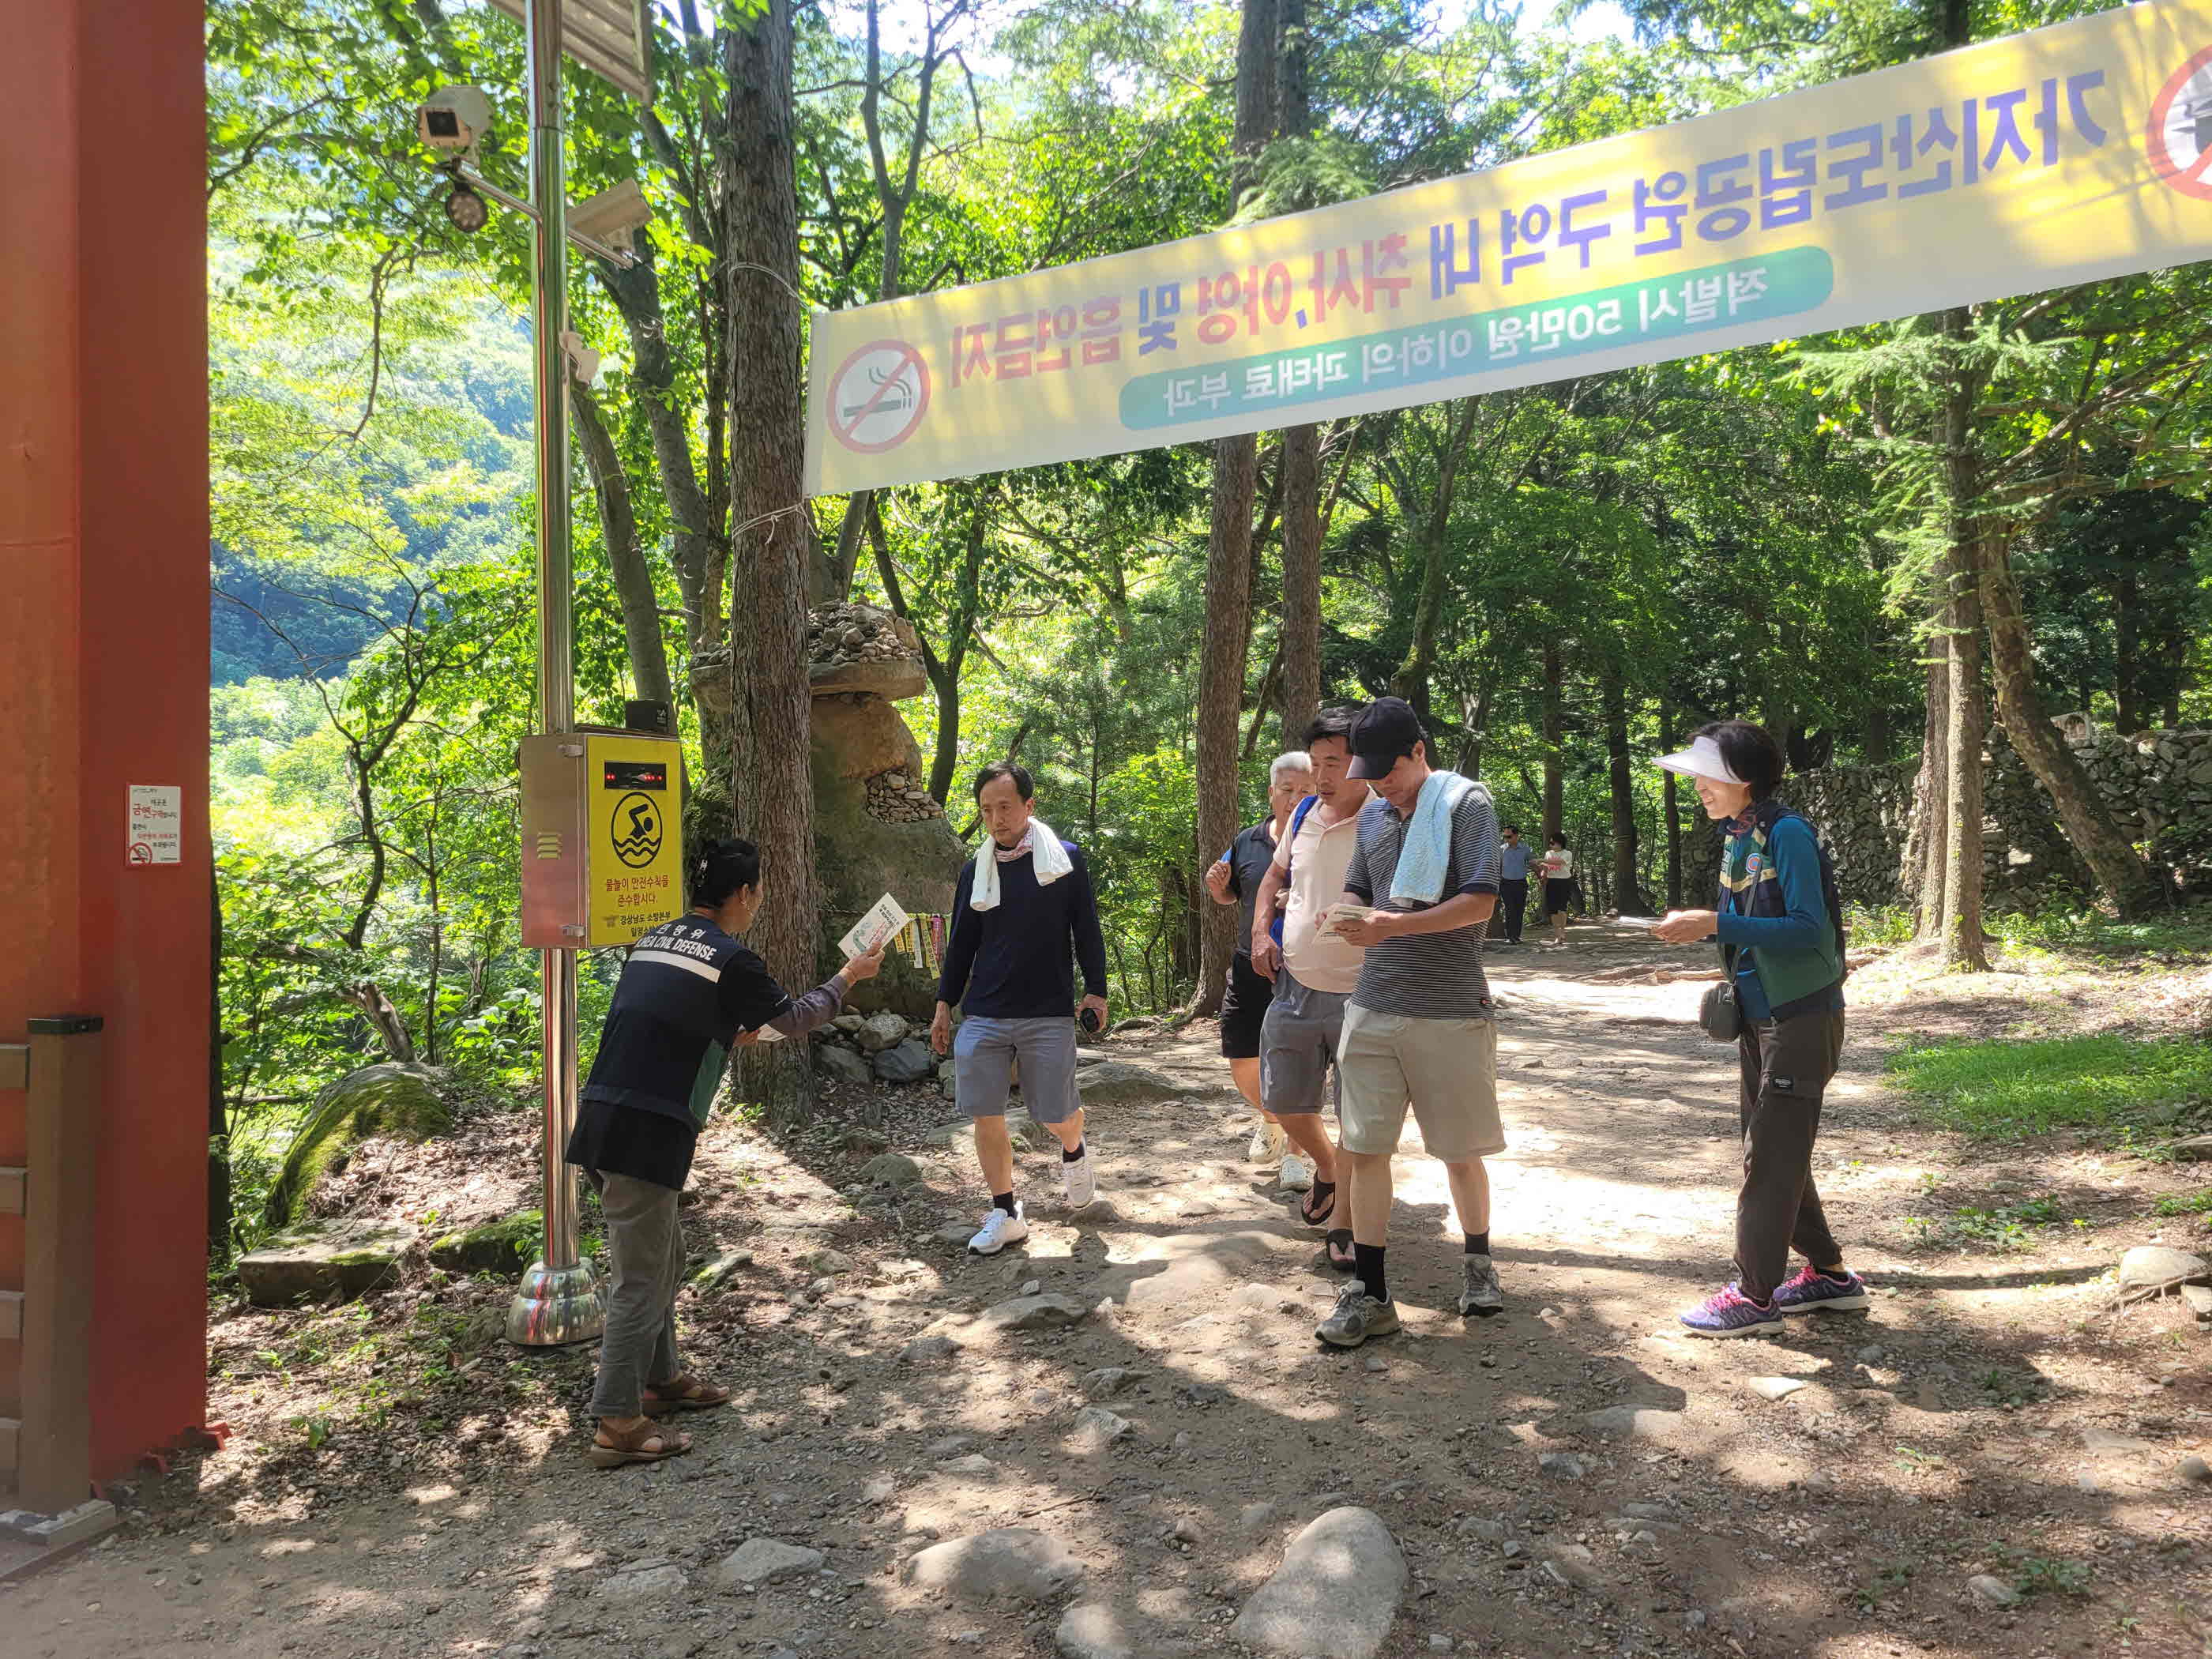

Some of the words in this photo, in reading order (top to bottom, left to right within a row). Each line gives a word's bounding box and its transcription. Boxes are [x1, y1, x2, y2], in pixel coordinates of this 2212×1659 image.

[606, 878, 629, 892] 물놀이
[618, 891, 658, 908] 준수합시다.
[619, 914, 645, 925] 경상남도
[636, 935, 657, 948] OREA
[653, 935, 675, 950] CIVIL
[672, 939, 717, 961] DEFENSE
